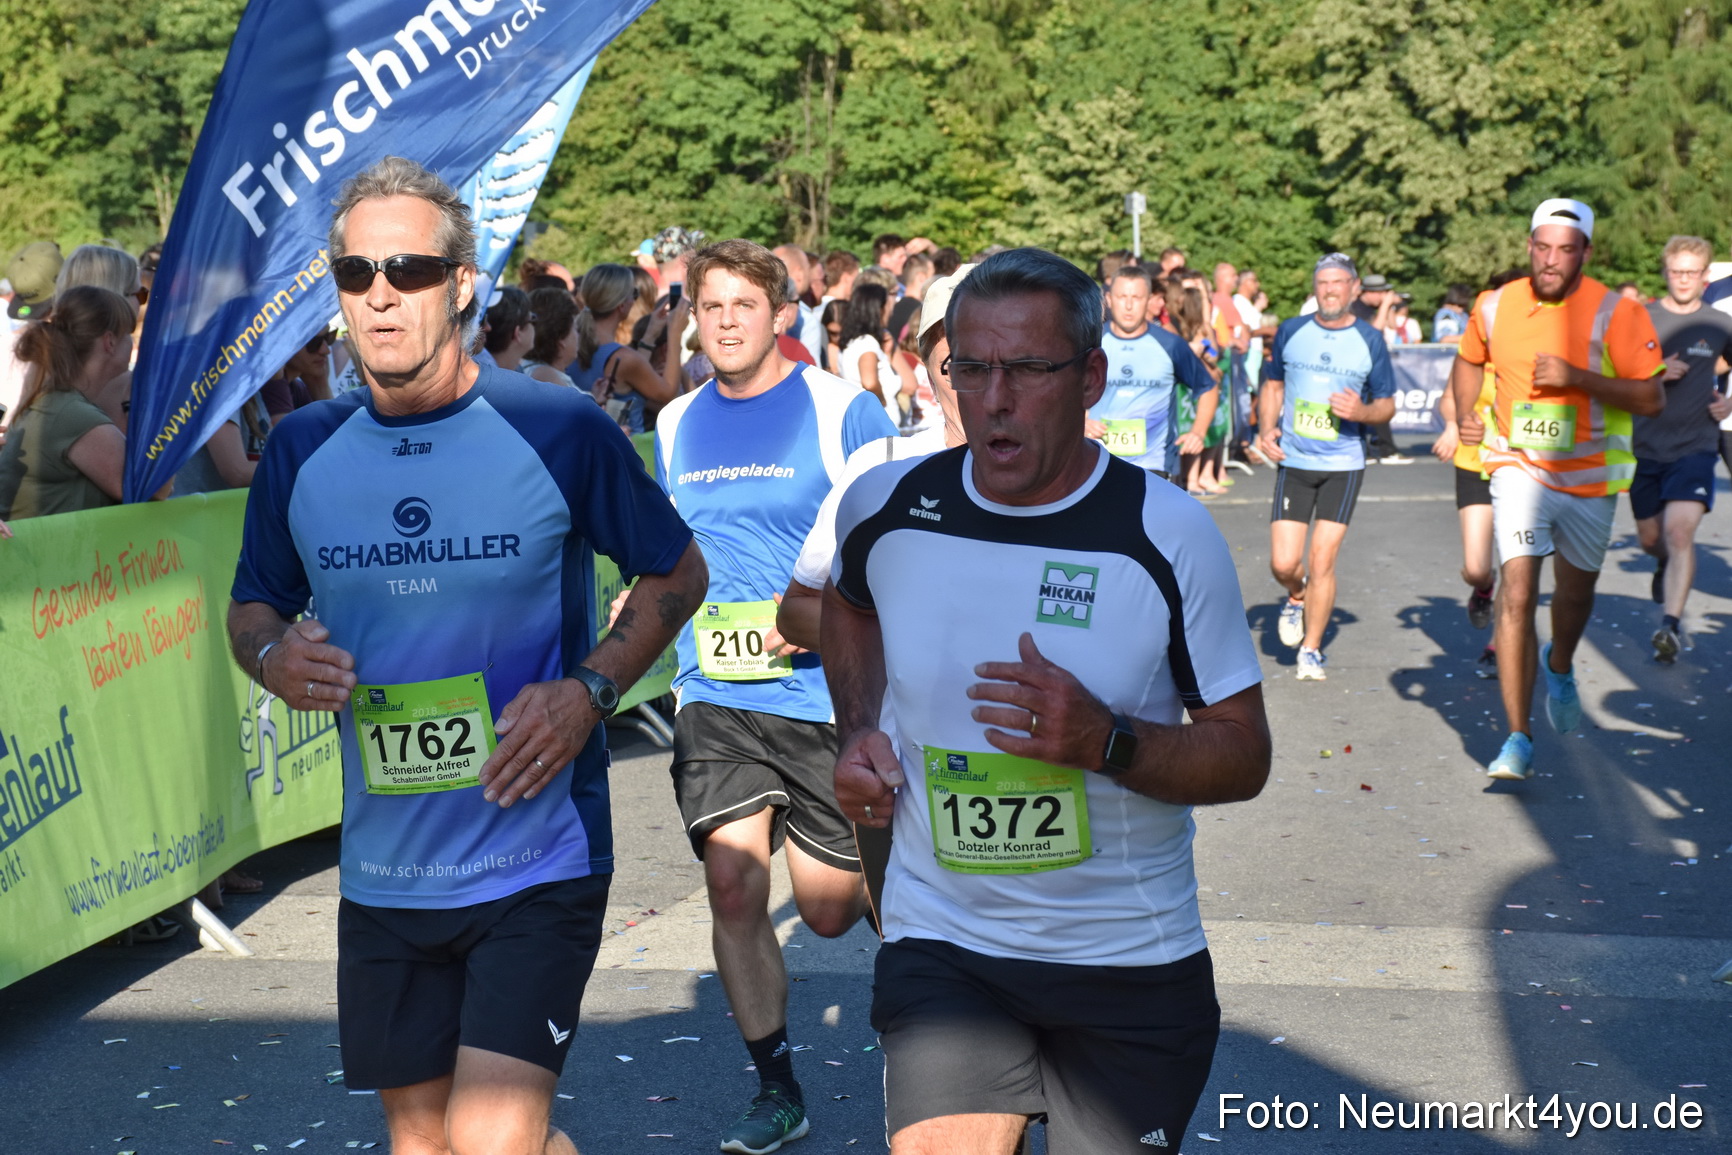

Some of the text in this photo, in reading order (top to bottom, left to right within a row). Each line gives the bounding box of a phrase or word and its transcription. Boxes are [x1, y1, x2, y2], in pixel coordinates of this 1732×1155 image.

[455, 0, 546, 80] Druck
[1299, 413, 1334, 430] 1769
[1523, 419, 1560, 437] 446
[678, 463, 795, 485] energiegeladen
[909, 508, 942, 522] erima
[1513, 530, 1536, 545] 18
[318, 533, 521, 571] SCHABMÜLLER
[387, 577, 438, 595] TEAM
[1039, 584, 1096, 604] MICKAN
[712, 630, 764, 657] 210
[739, 658, 764, 666] Tobias
[364, 701, 405, 712] firmenlauf
[412, 706, 438, 718] 2018
[370, 717, 476, 763] 1762
[382, 758, 470, 775] Schneider Alfred
[940, 767, 989, 782] firmenlauf
[0, 704, 82, 848] enlauf
[392, 771, 461, 784] Schabmüller GmbH
[996, 781, 1026, 791] 2018
[943, 794, 1065, 839] 1372
[955, 851, 1036, 861] General-Bau-Gesellschaft
[1037, 848, 1064, 859] Amberg
[1065, 848, 1081, 856] mbH
[957, 840, 1051, 853] Dotzler Konrad
[361, 848, 542, 878] www.schabmueller.de
[0, 850, 26, 895] arkt
